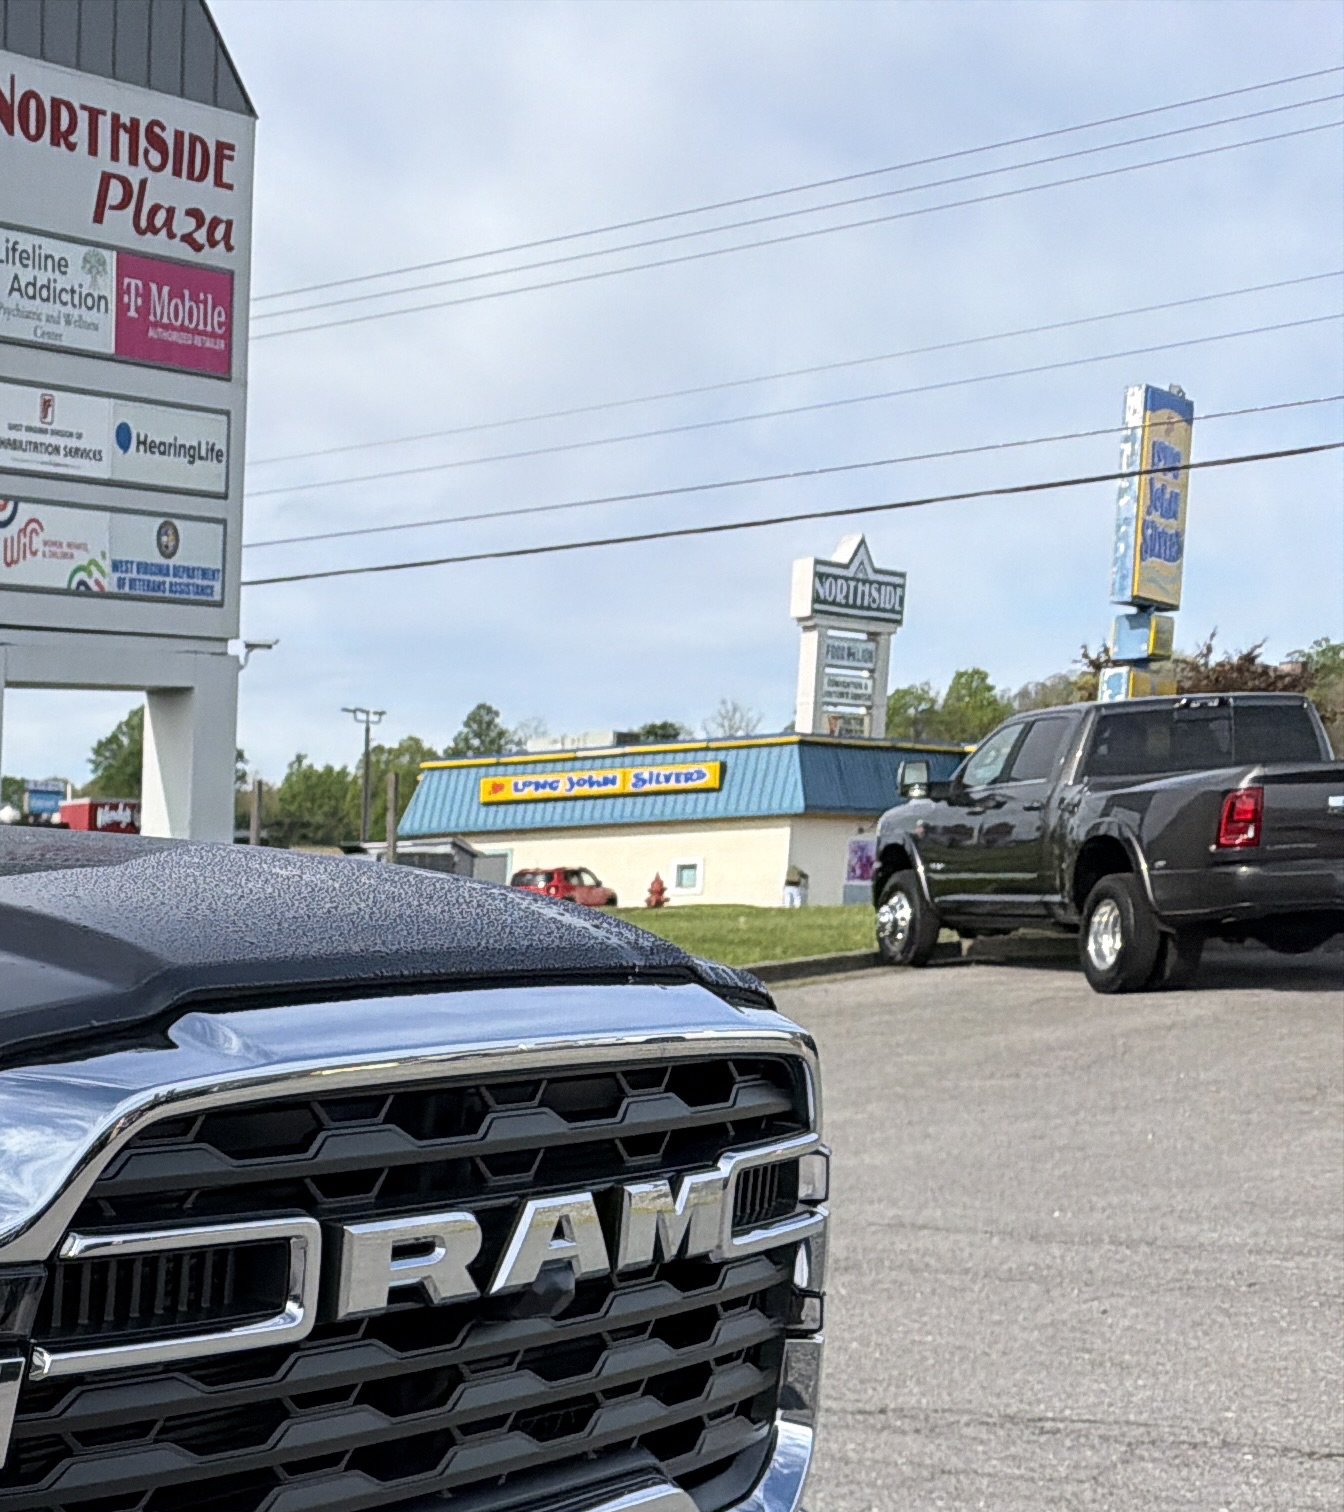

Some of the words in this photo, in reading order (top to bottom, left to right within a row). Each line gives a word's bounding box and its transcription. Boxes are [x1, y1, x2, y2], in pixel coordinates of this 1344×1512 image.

[92, 170, 236, 254] Plaza
[7, 272, 109, 314] Addiction
[148, 281, 226, 334] Mobile
[33, 325, 63, 342] Center
[45, 310, 61, 325] and
[63, 446, 103, 462] SERVICES
[135, 431, 224, 465] HearingLife
[112, 558, 134, 574] WEST
[172, 564, 221, 582] DEPARTMENT
[116, 576, 126, 590] OF
[168, 580, 215, 598] ASSISTANCE
[815, 575, 904, 611] NORTHSIDE
[337, 1168, 726, 1320] RAM
